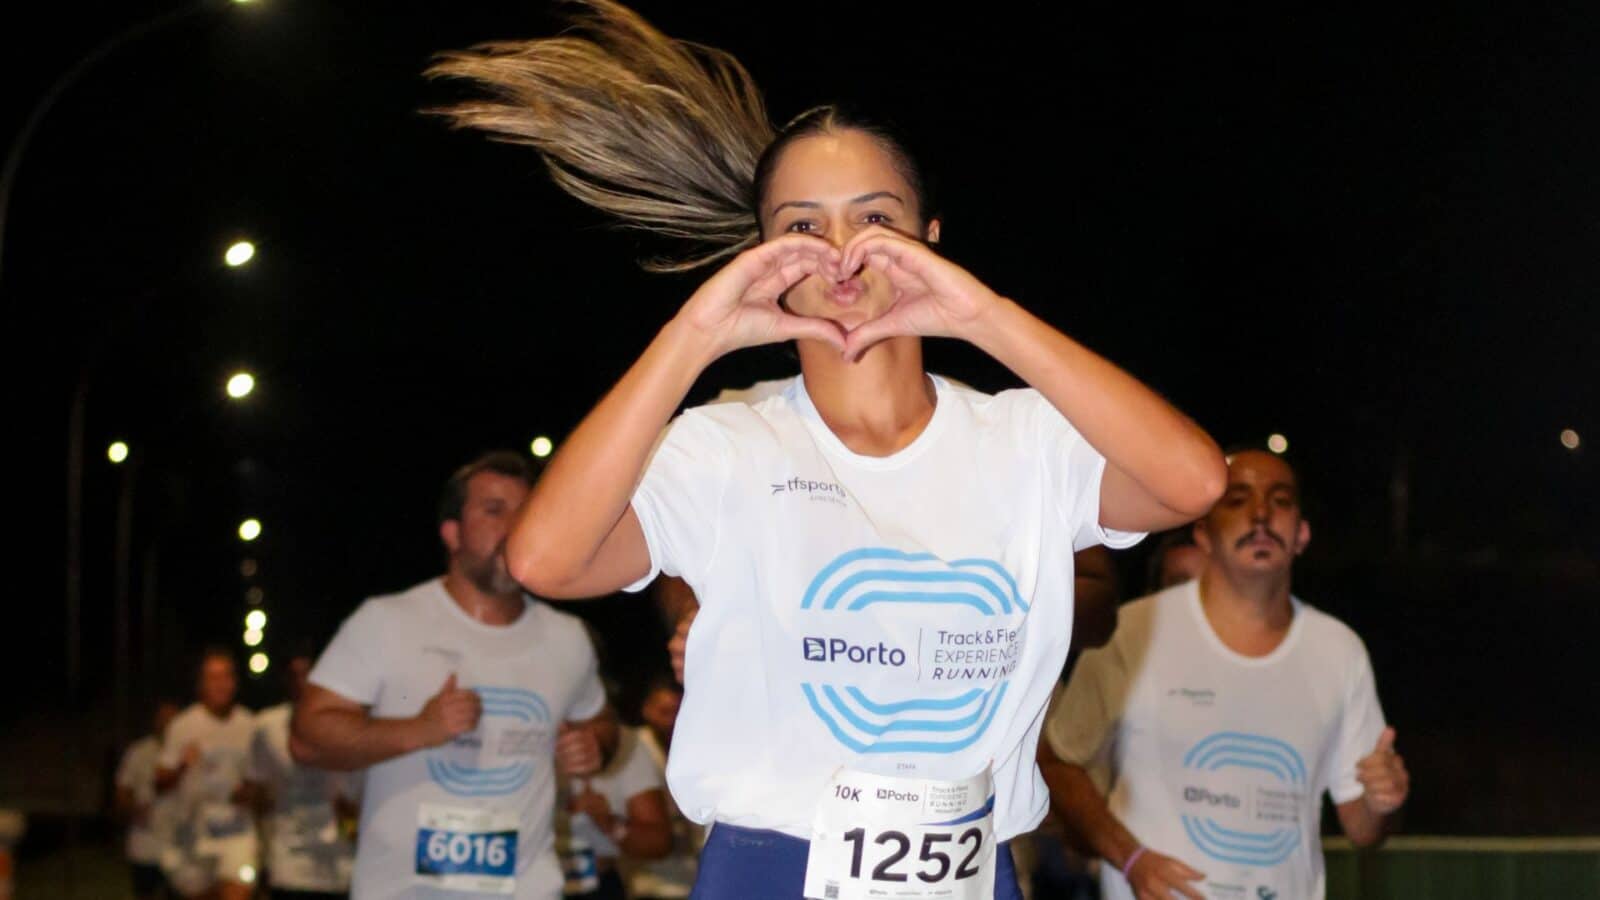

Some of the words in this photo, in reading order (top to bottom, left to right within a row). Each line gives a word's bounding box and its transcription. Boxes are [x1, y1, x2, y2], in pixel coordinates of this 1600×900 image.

[830, 638, 906, 667] Porto
[834, 784, 862, 802] 10K
[887, 789, 919, 803] Porto
[427, 830, 507, 867] 6016
[843, 826, 982, 883] 1252
